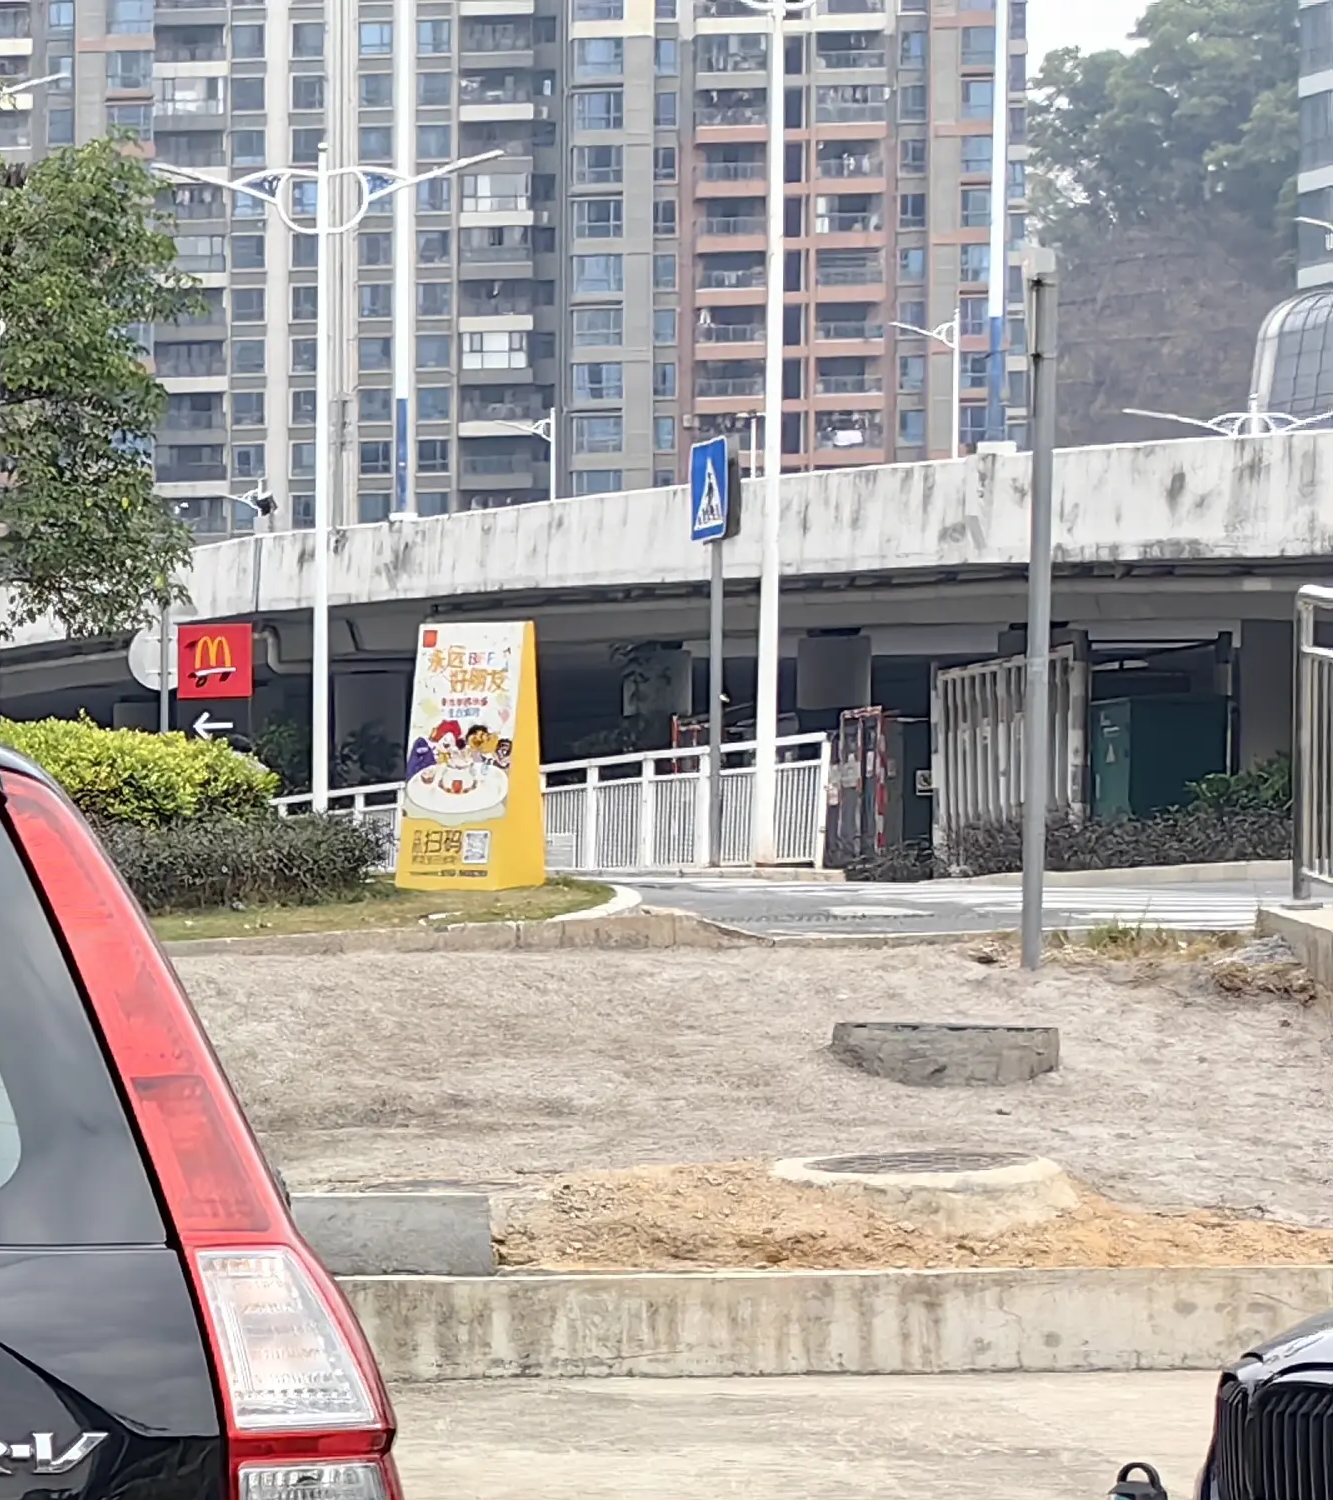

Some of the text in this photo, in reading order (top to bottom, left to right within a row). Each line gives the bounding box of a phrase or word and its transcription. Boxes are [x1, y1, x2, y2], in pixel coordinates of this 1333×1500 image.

[450, 667, 508, 693] 好朋友
[424, 829, 463, 854] 扫码
